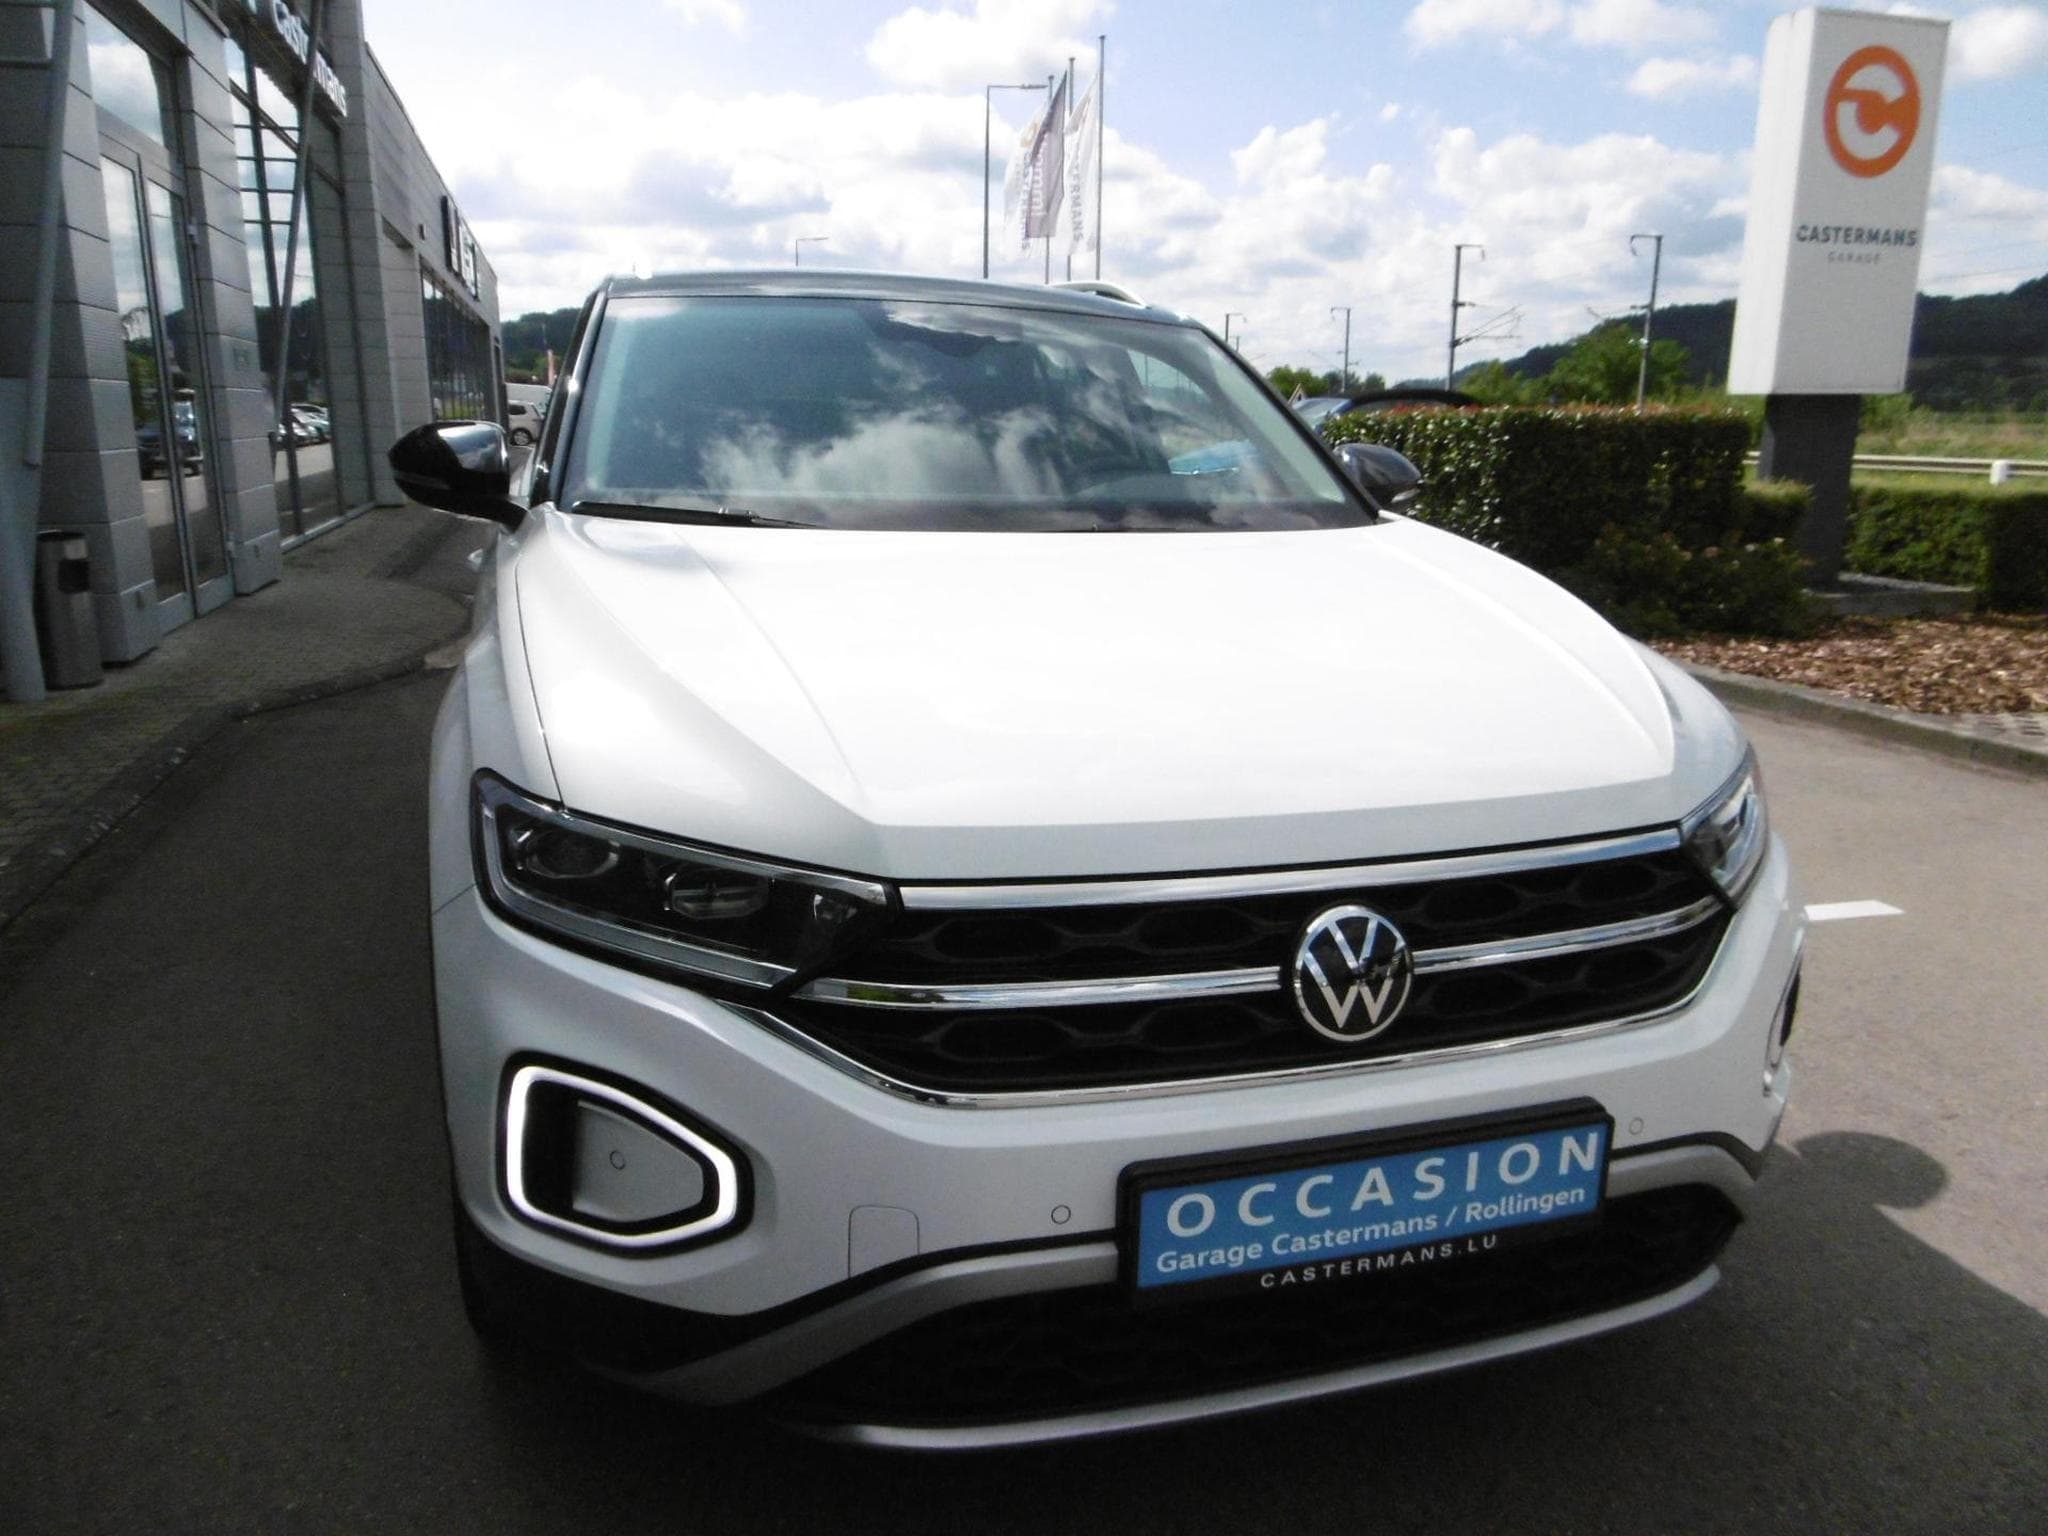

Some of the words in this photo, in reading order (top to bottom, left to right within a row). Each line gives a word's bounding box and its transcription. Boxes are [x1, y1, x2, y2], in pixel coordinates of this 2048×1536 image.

[1796, 224, 1918, 246] CASTERMANS
[1166, 1132, 1599, 1238] OCCASION
[1156, 1243, 1263, 1274] Garage
[1271, 1213, 1438, 1257] Castermans
[1445, 1206, 1459, 1227] /
[1464, 1187, 1586, 1225] Rollingen
[1260, 1233, 1497, 1289] CASTERMANS.LU
